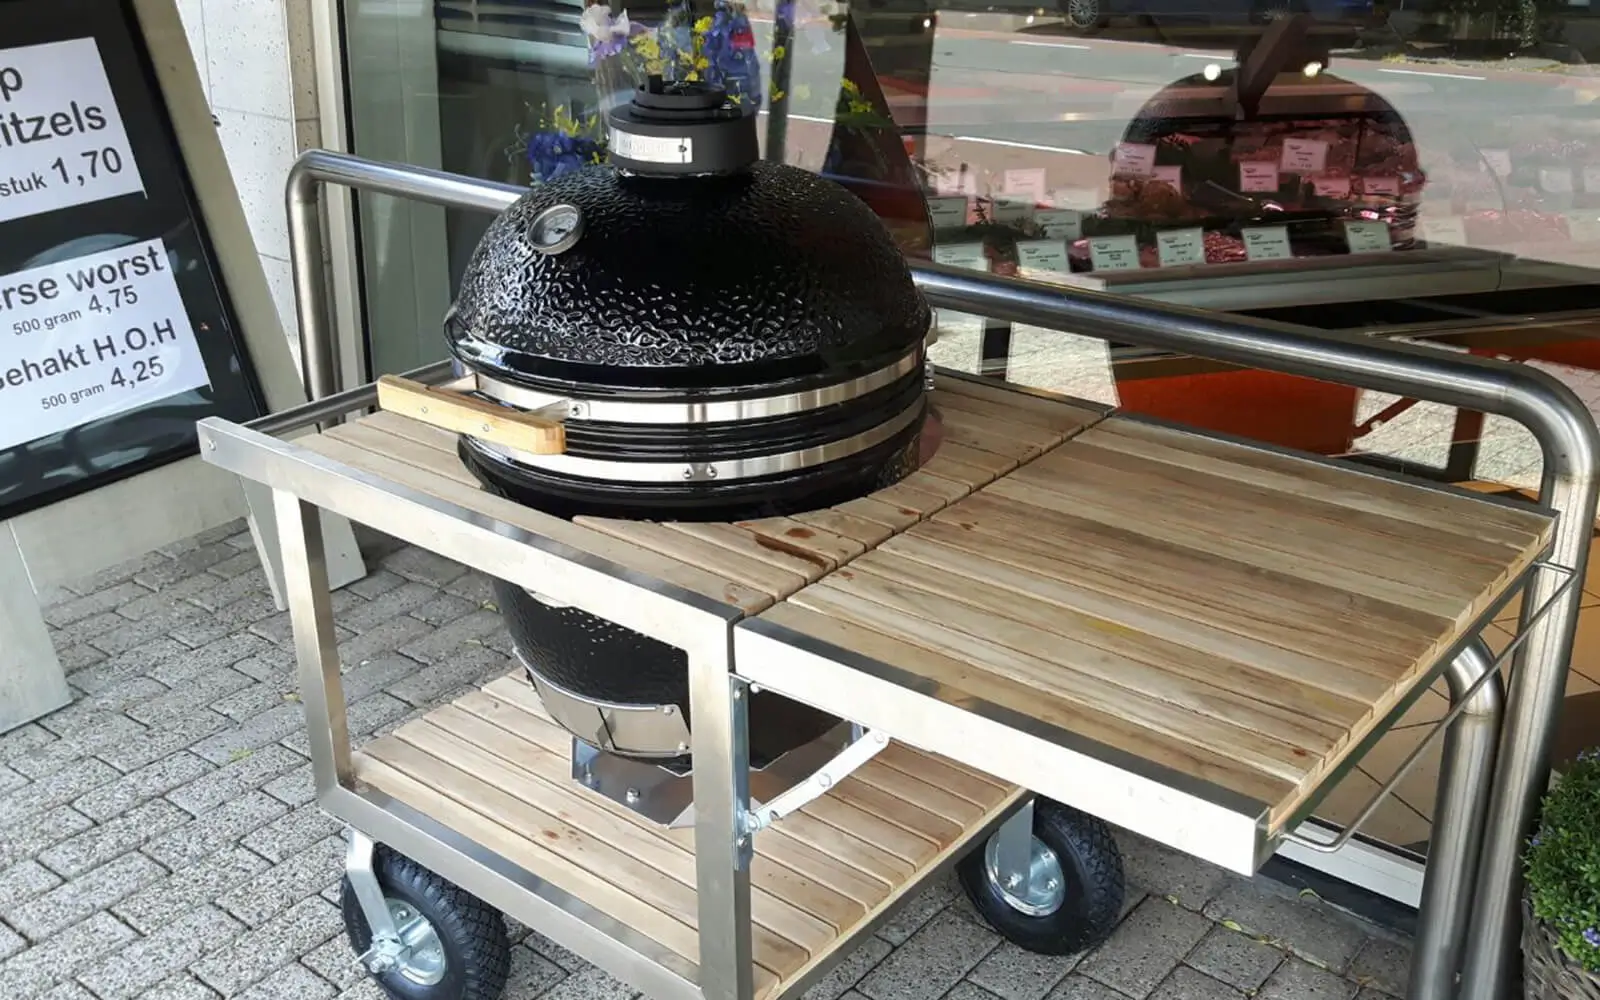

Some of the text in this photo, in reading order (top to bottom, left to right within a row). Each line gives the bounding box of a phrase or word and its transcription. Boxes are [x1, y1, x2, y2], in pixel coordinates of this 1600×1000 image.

[0, 100, 107, 148] itzels
[0, 147, 122, 197] stuk 1,70
[0, 246, 164, 312] rse worst
[13, 285, 138, 336] 500 gram 4,75
[0, 318, 177, 390] ehakt H.O.H
[41, 356, 164, 410] 500 gram 4,25
